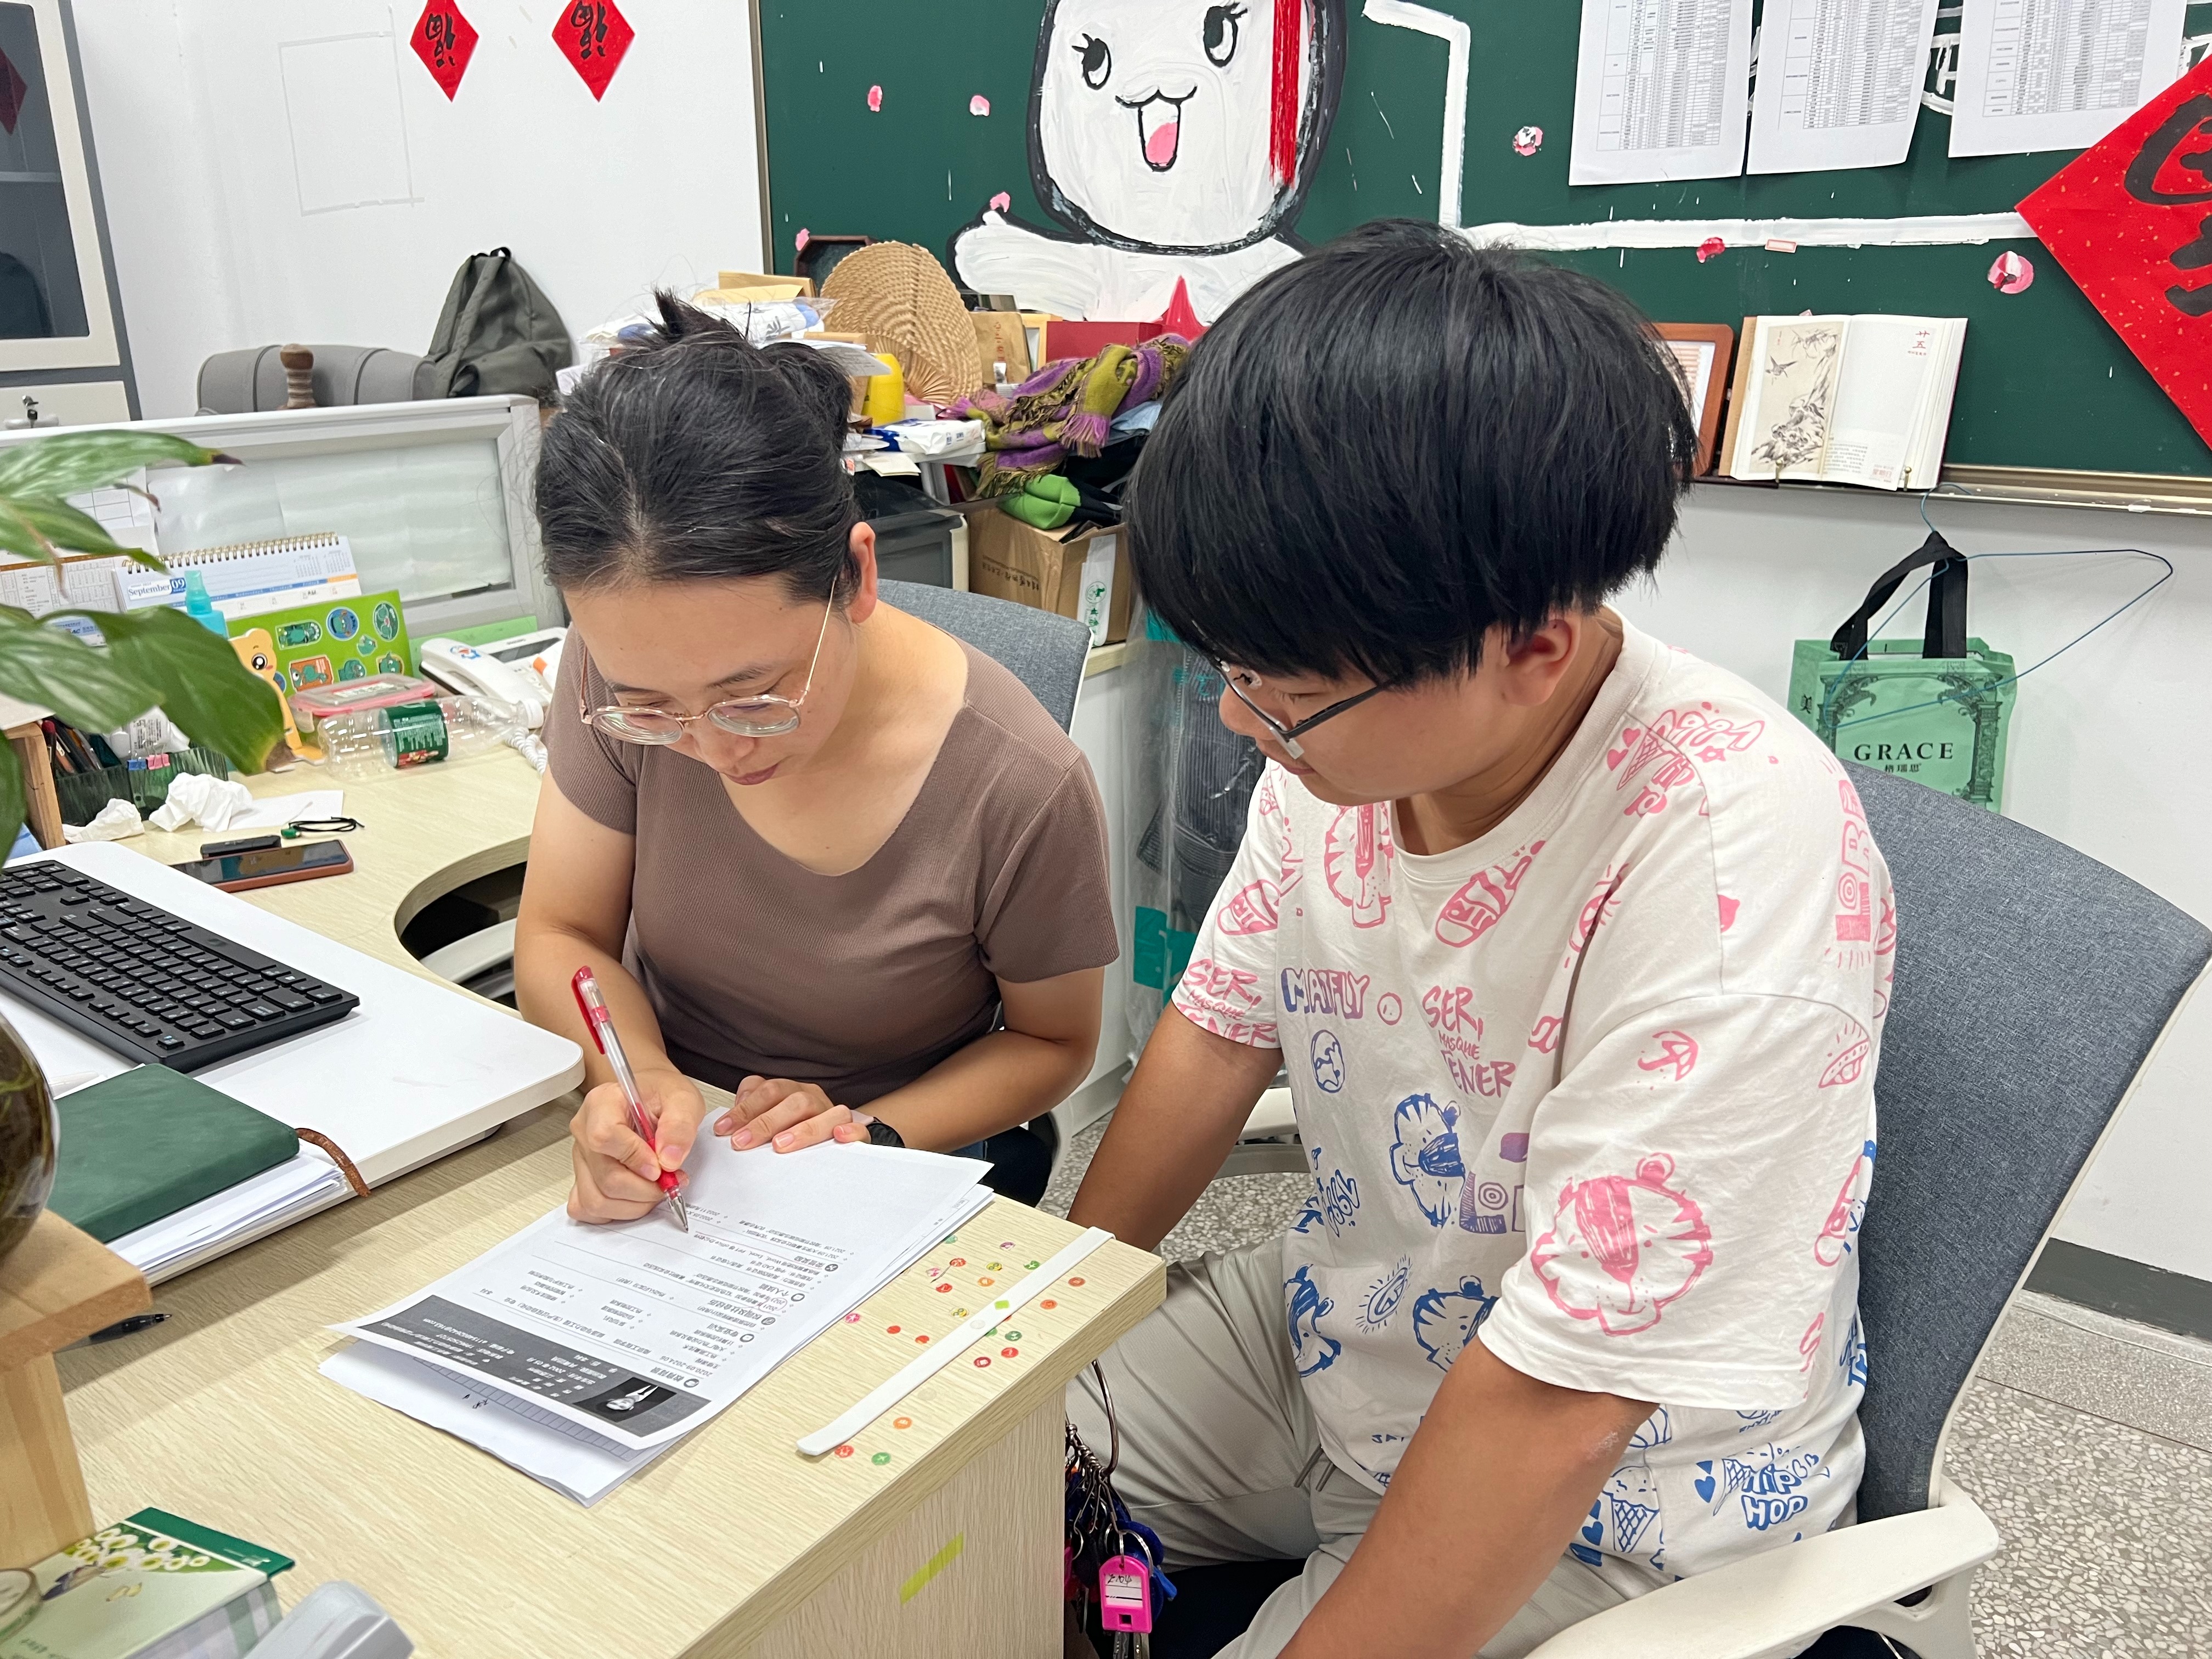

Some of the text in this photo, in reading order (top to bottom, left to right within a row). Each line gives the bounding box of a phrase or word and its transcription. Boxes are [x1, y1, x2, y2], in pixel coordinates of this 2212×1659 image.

[128, 584, 170, 597] September
[171, 578, 185, 589] 09
[1854, 742, 1954, 761] GRACE
[1182, 958, 1263, 1010] SER,
[1187, 989, 1246, 1020] MASQUE
[1422, 985, 1484, 1042] SER,
[1438, 1029, 1480, 1060] MASQUE
[757, 1282, 792, 1297] 个人技能
[706, 1297, 763, 1321] 校园及社会经历
[705, 1322, 741, 1338] 专业实训
[648, 1365, 686, 1383] 教育背景
[1740, 1494, 1809, 1531] HOP
